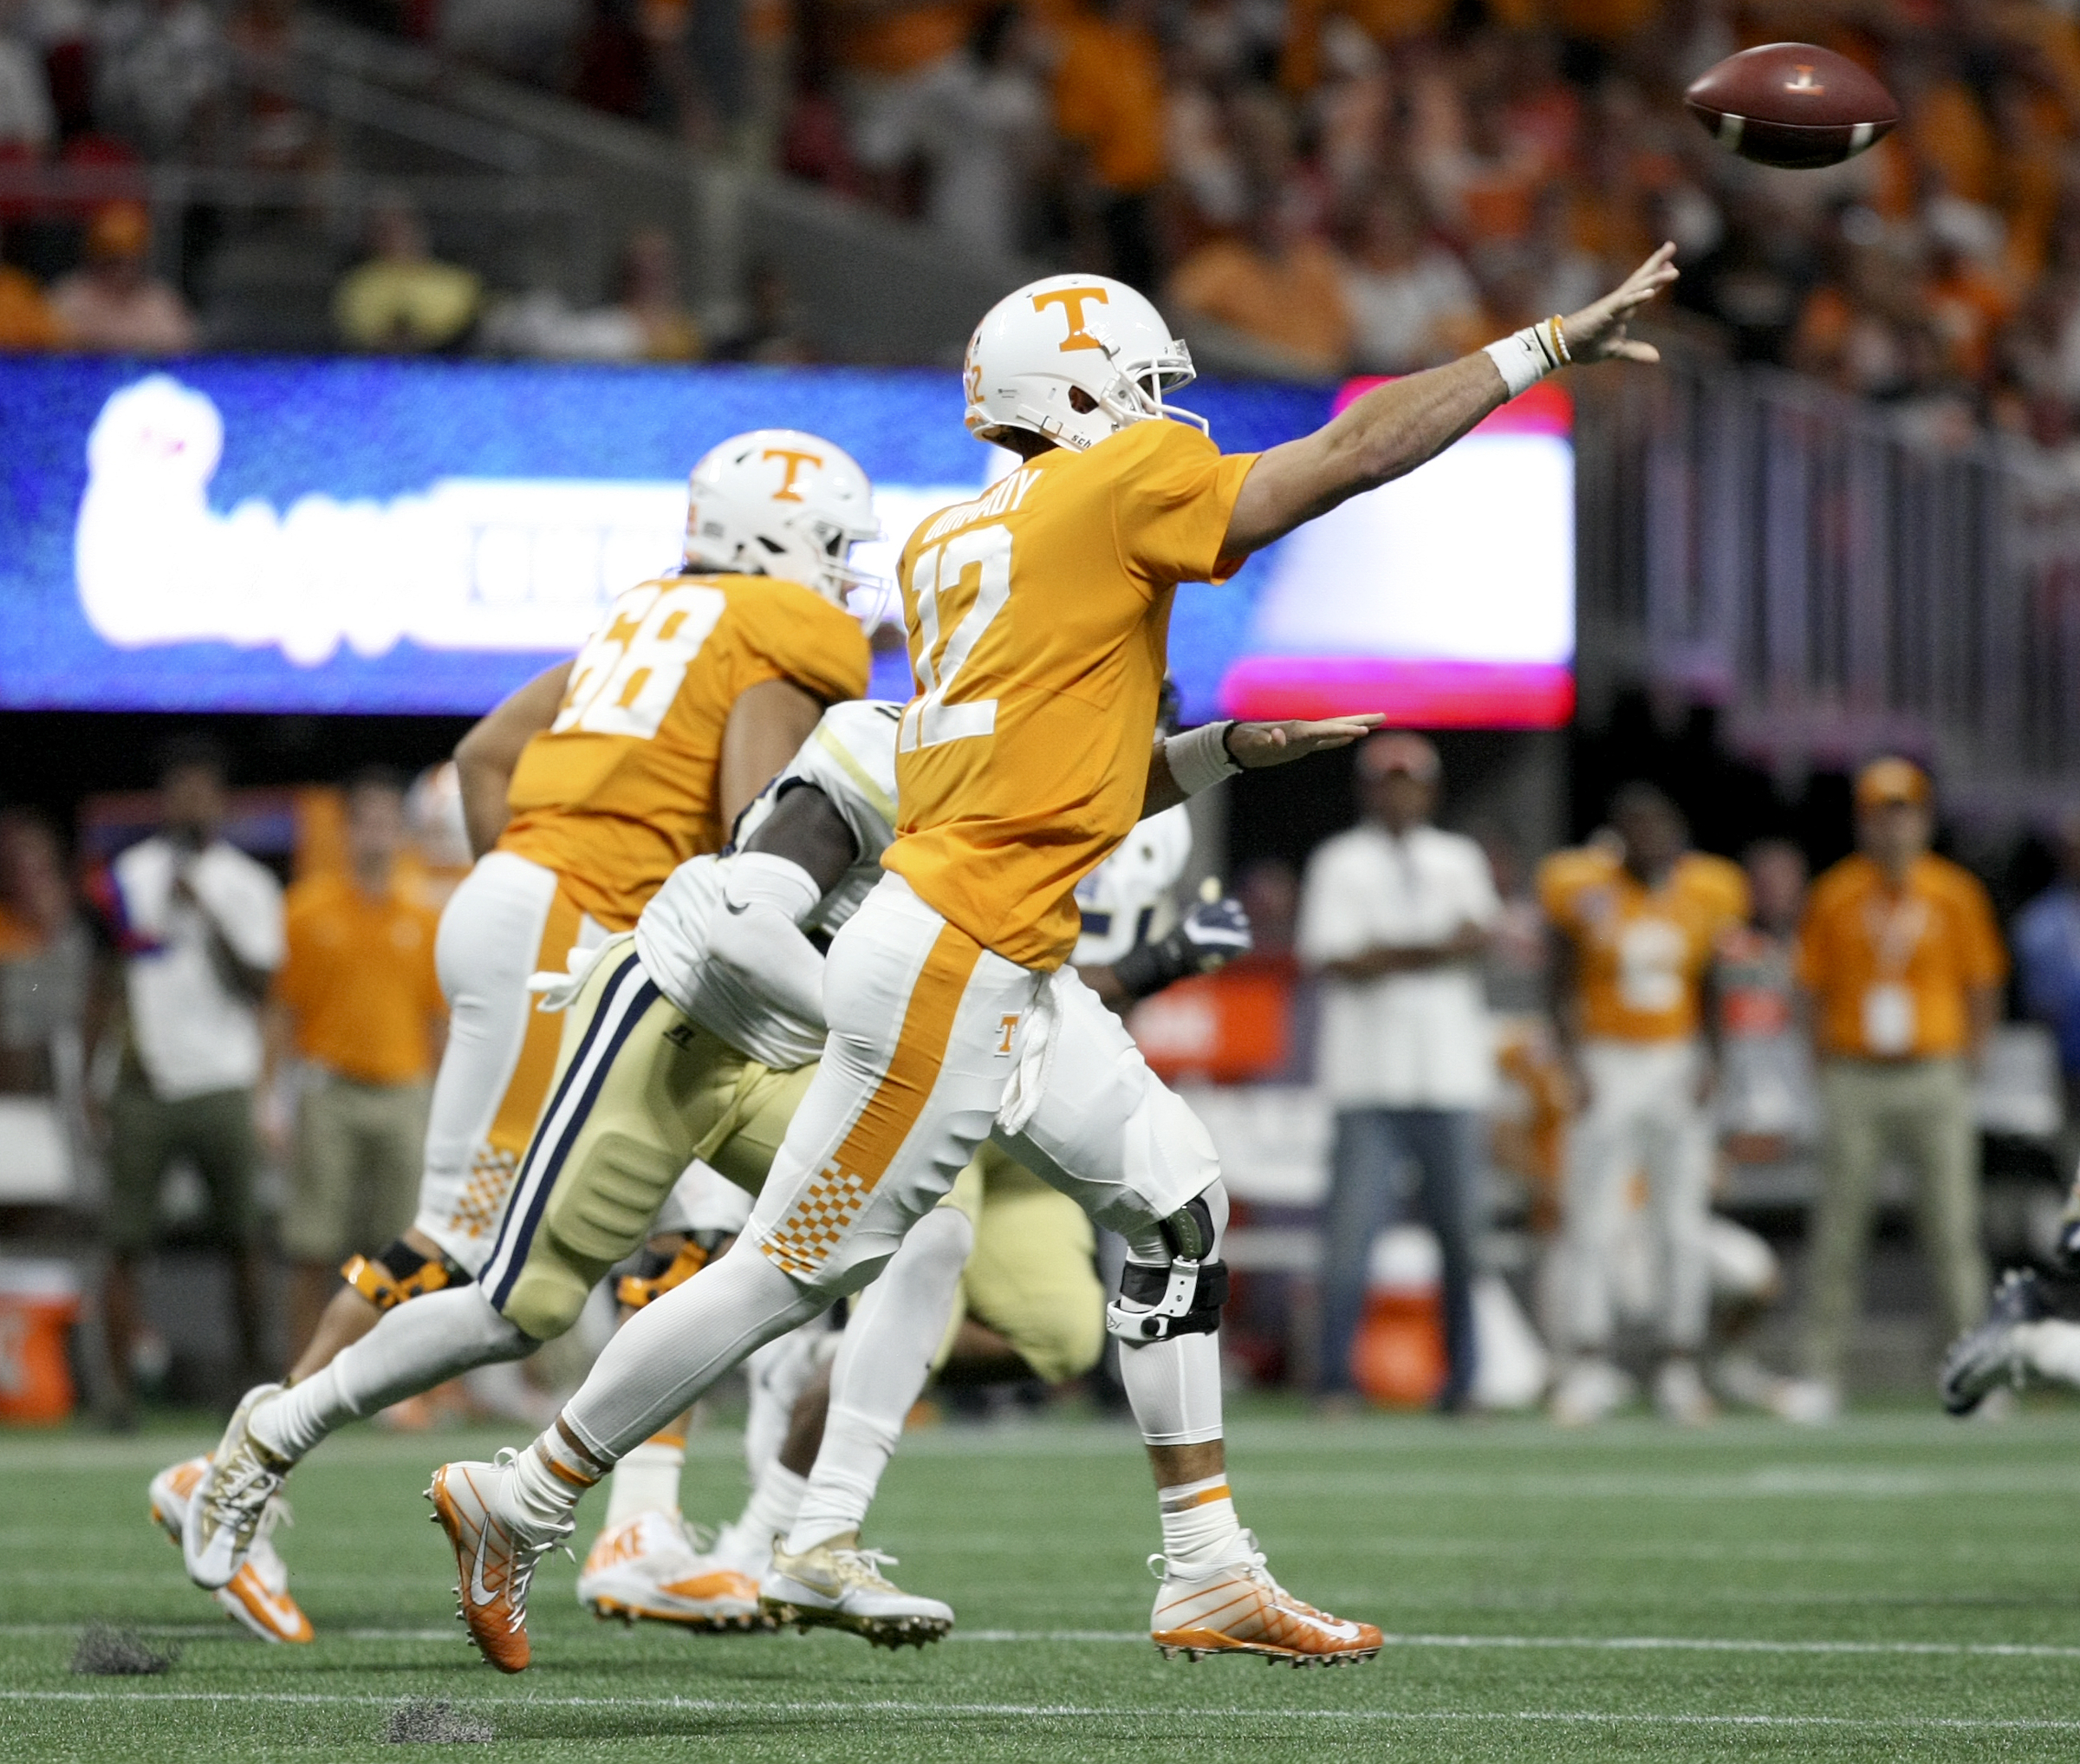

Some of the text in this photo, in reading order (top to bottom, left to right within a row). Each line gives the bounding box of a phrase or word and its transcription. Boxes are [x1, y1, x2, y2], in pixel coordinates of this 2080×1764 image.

[1031, 286, 1109, 353] T
[761, 449, 824, 504] T
[549, 584, 726, 740] 68
[899, 523, 1014, 754] 12
[995, 1012, 1022, 1058] T
